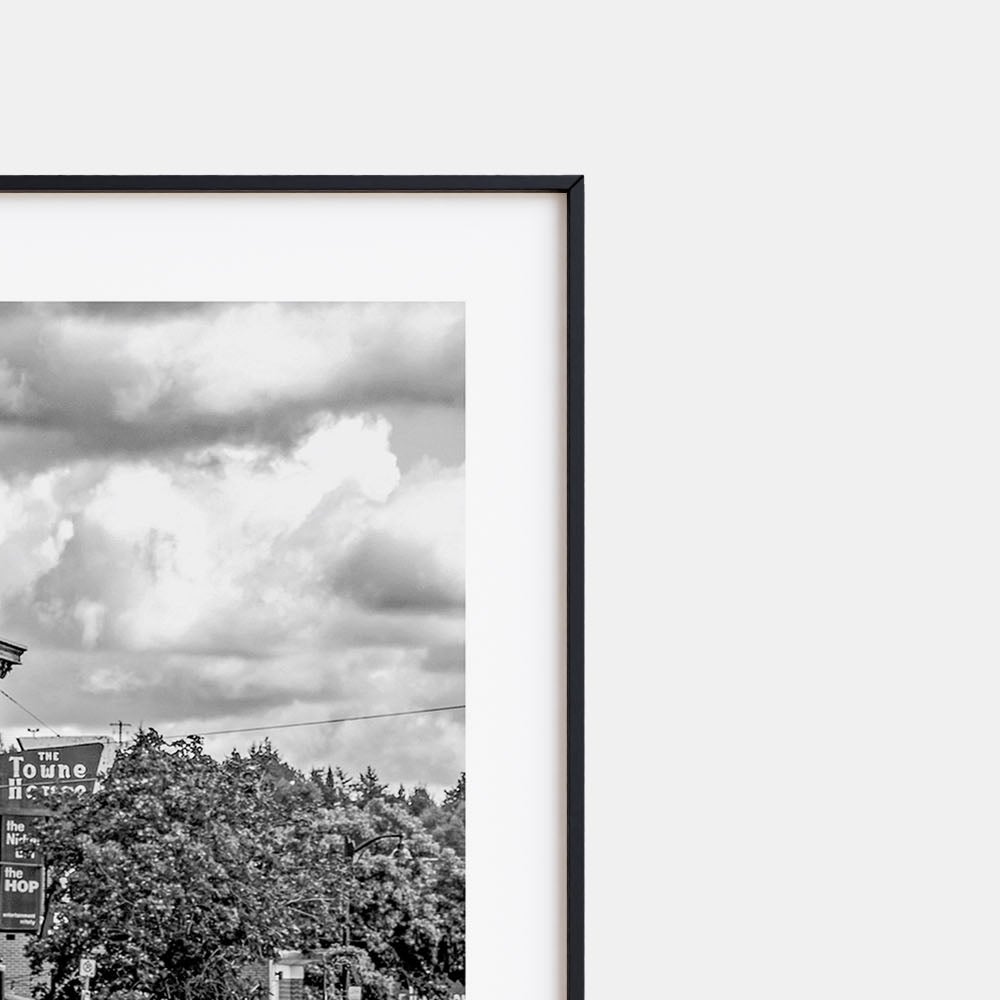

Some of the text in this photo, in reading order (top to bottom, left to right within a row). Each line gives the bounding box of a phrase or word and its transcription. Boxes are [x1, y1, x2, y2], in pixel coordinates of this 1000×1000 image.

[38, 752, 60, 761] THE
[9, 756, 87, 778] Towne
[6, 820, 25, 832] the
[4, 867, 24, 879] the
[4, 879, 40, 893] HOP
